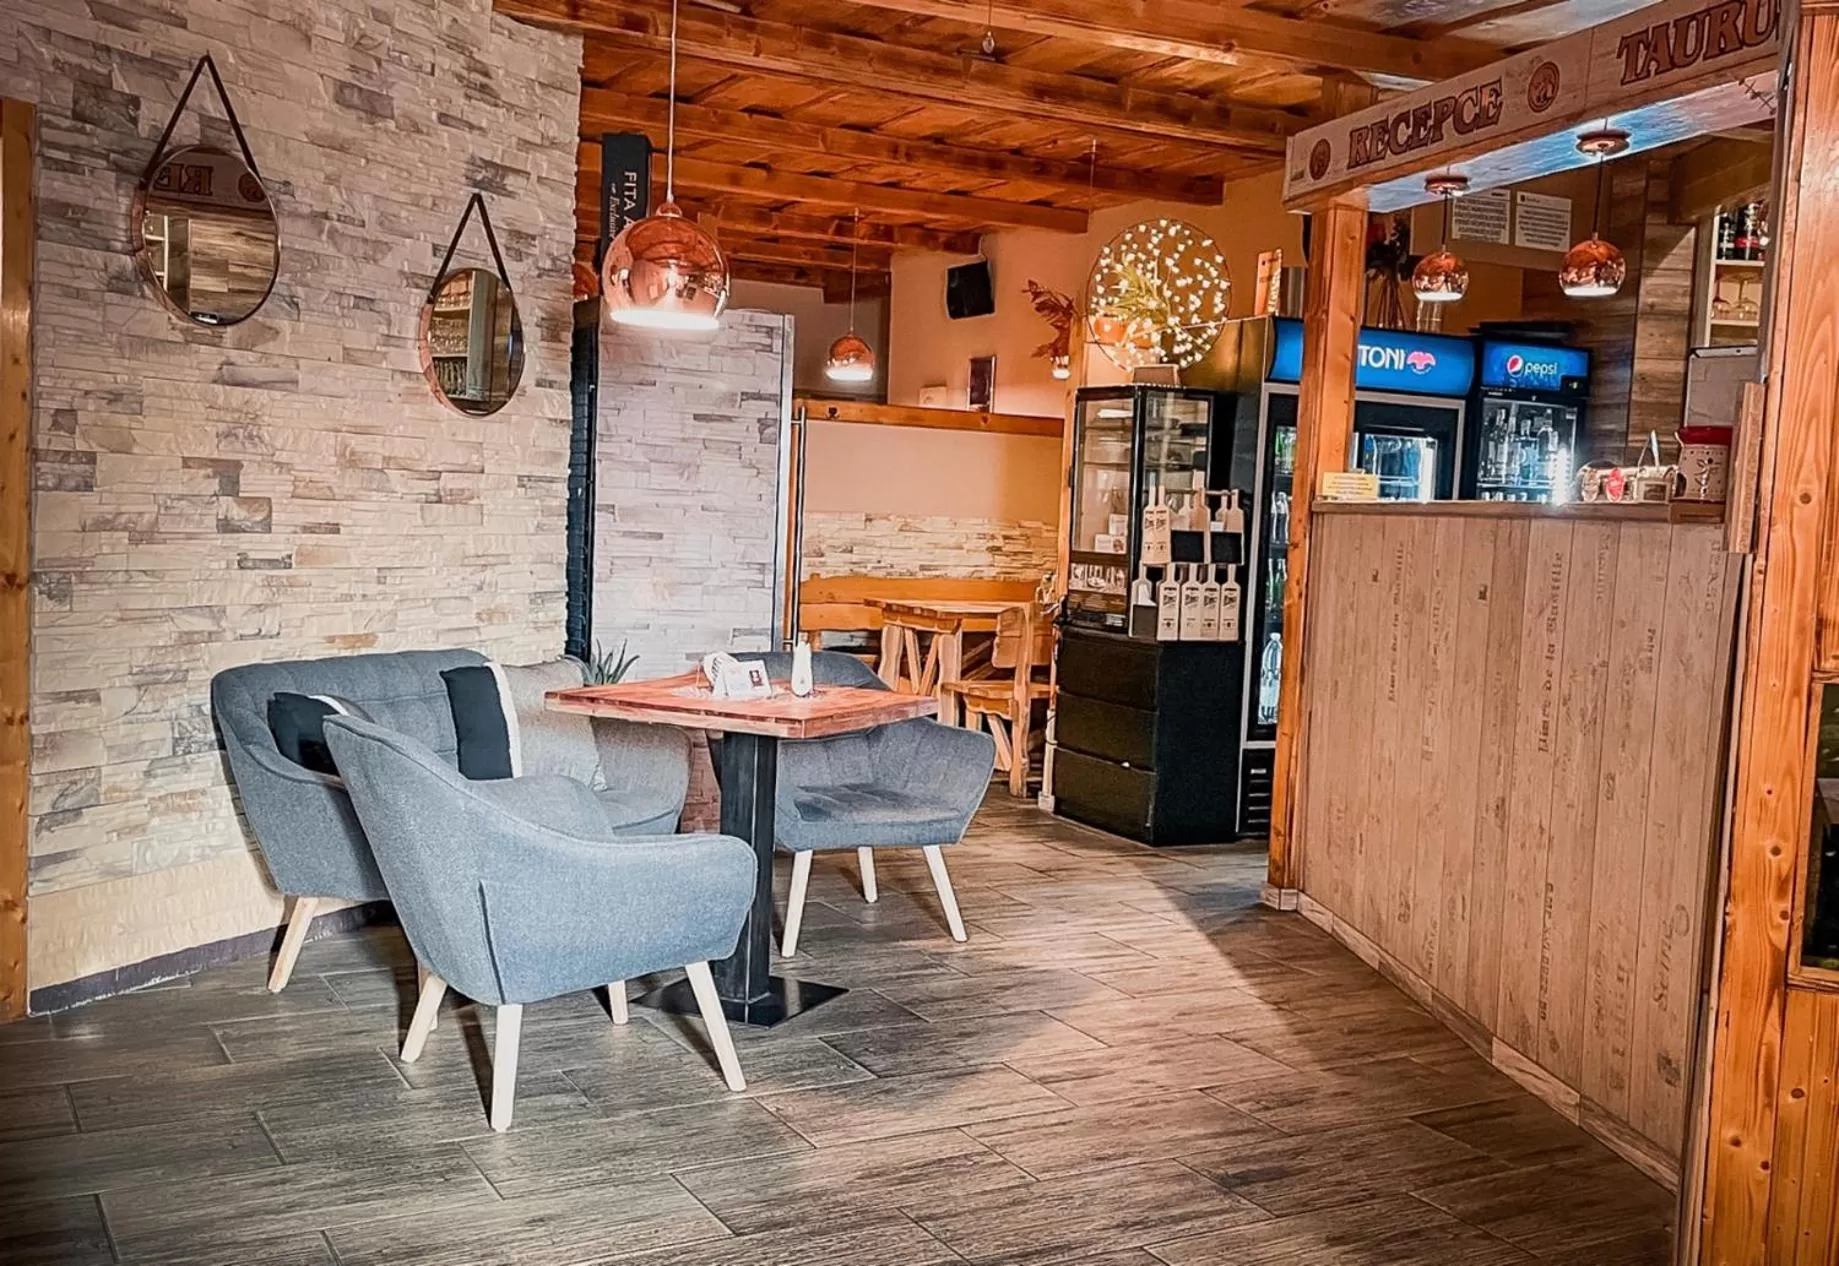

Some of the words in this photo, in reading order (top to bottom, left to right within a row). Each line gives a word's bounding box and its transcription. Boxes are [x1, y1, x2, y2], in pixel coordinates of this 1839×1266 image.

[1347, 76, 1503, 170] RECEPCE
[1616, 0, 1780, 86] TAURU
[624, 171, 637, 211] FITA
[1357, 344, 1406, 371] TONI
[1524, 362, 1558, 378] pepsi
